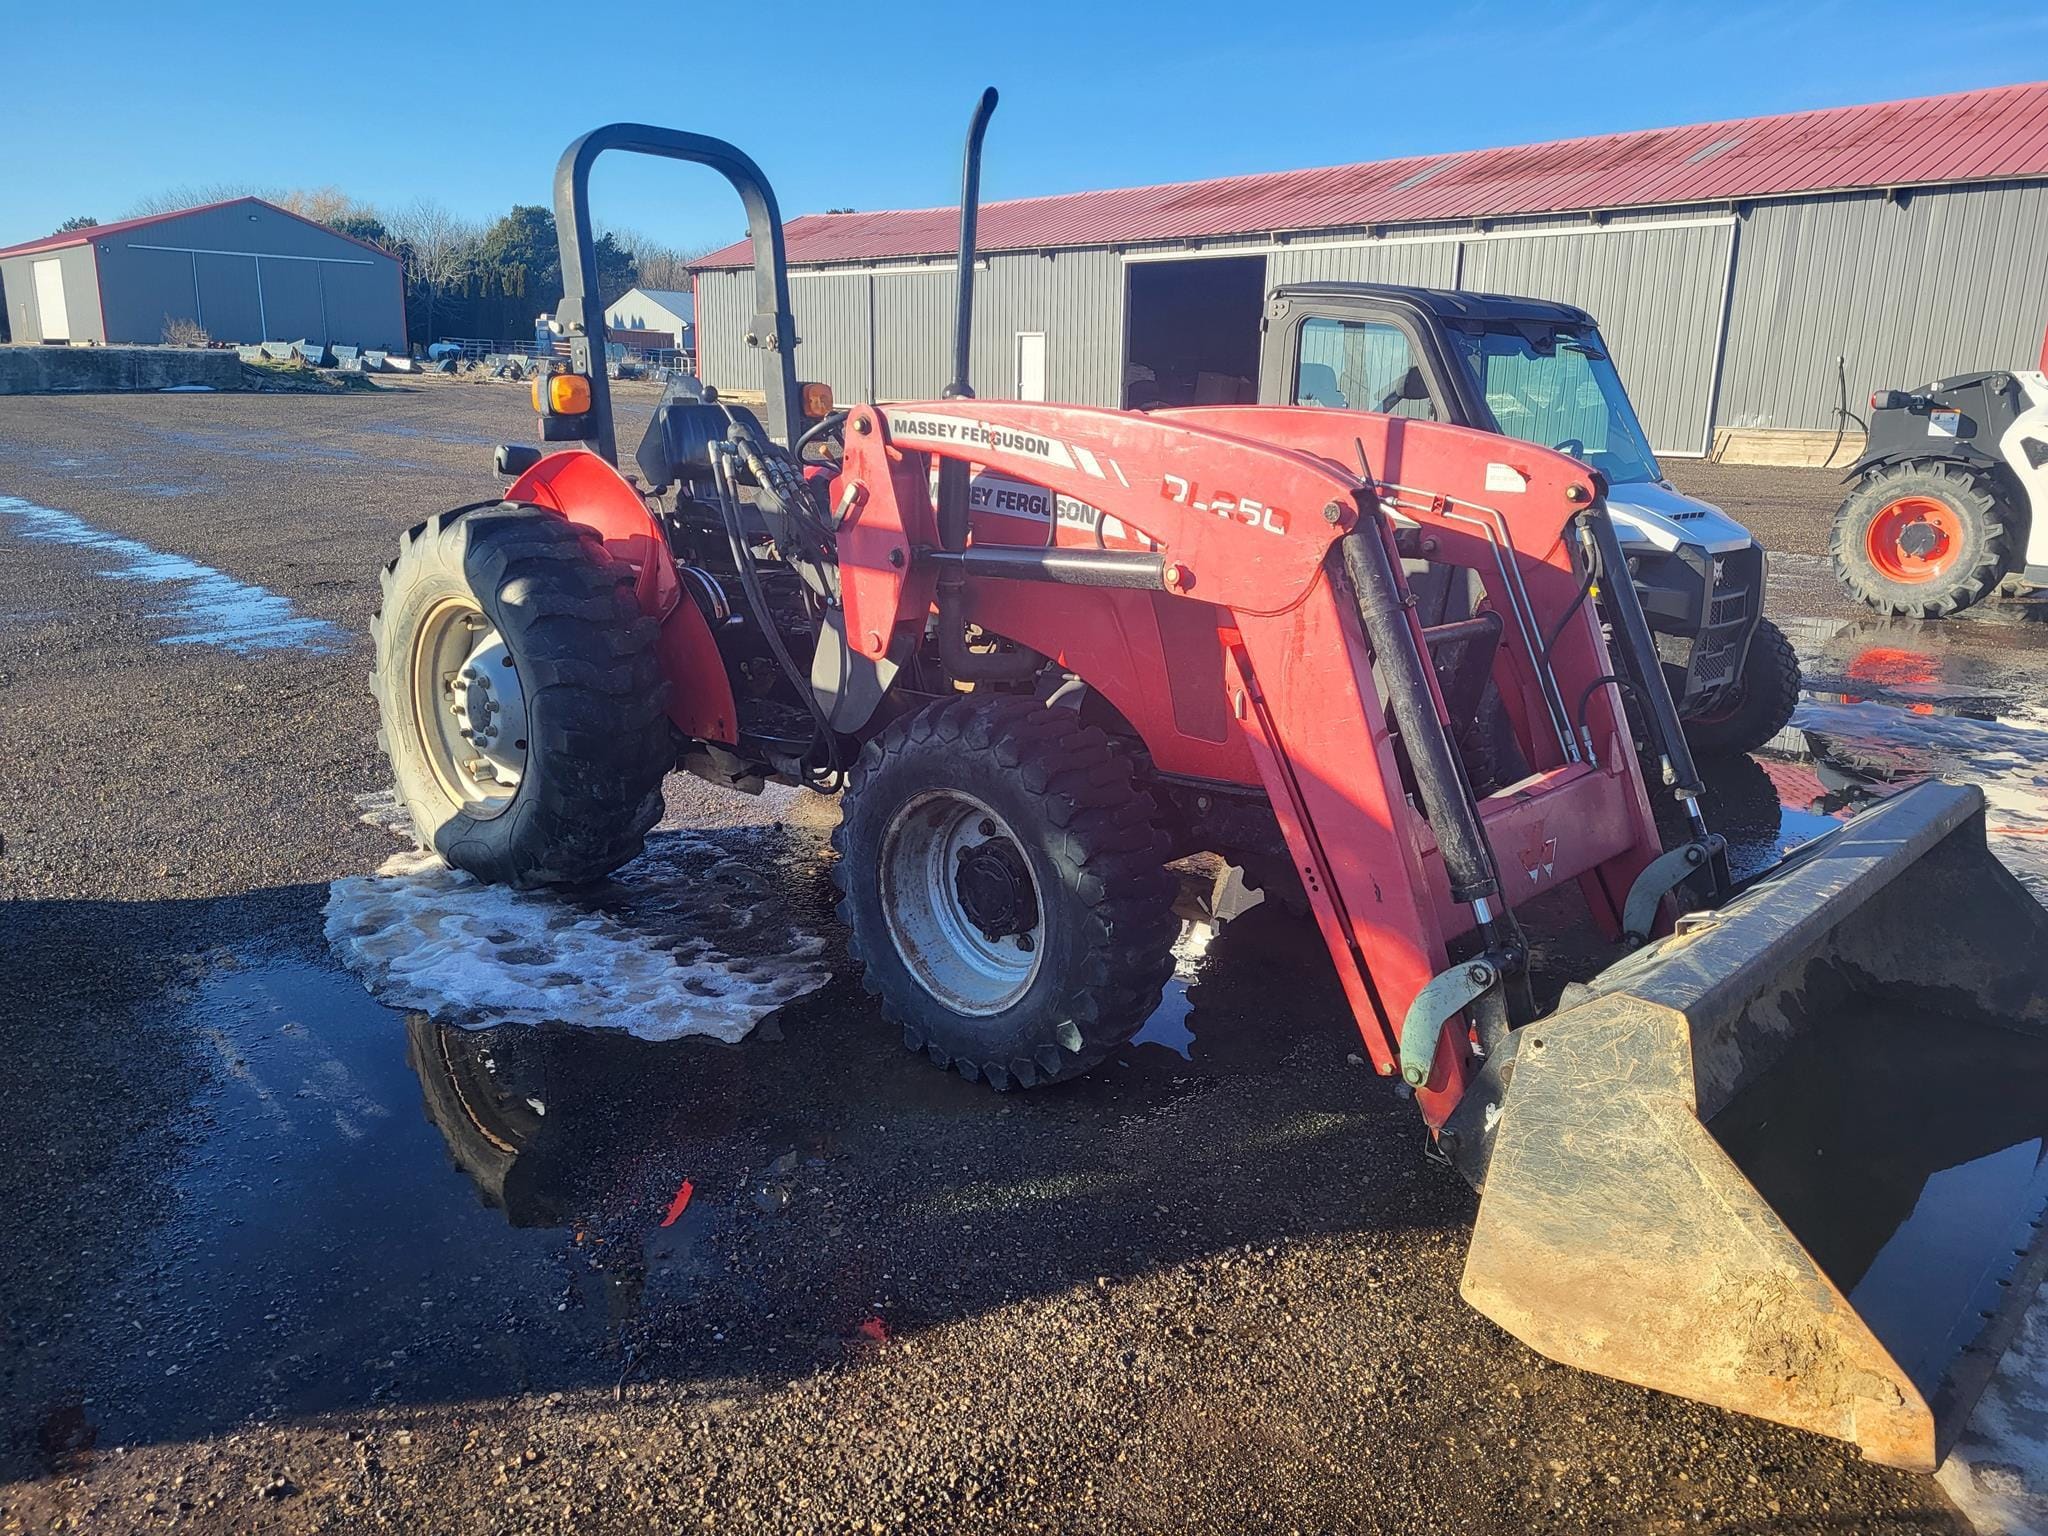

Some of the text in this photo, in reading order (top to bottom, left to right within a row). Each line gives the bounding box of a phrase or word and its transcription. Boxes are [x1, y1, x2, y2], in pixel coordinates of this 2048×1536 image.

[894, 419, 1050, 457] MASSEY FERGUSON
[996, 489, 1096, 525] FERGUSON
